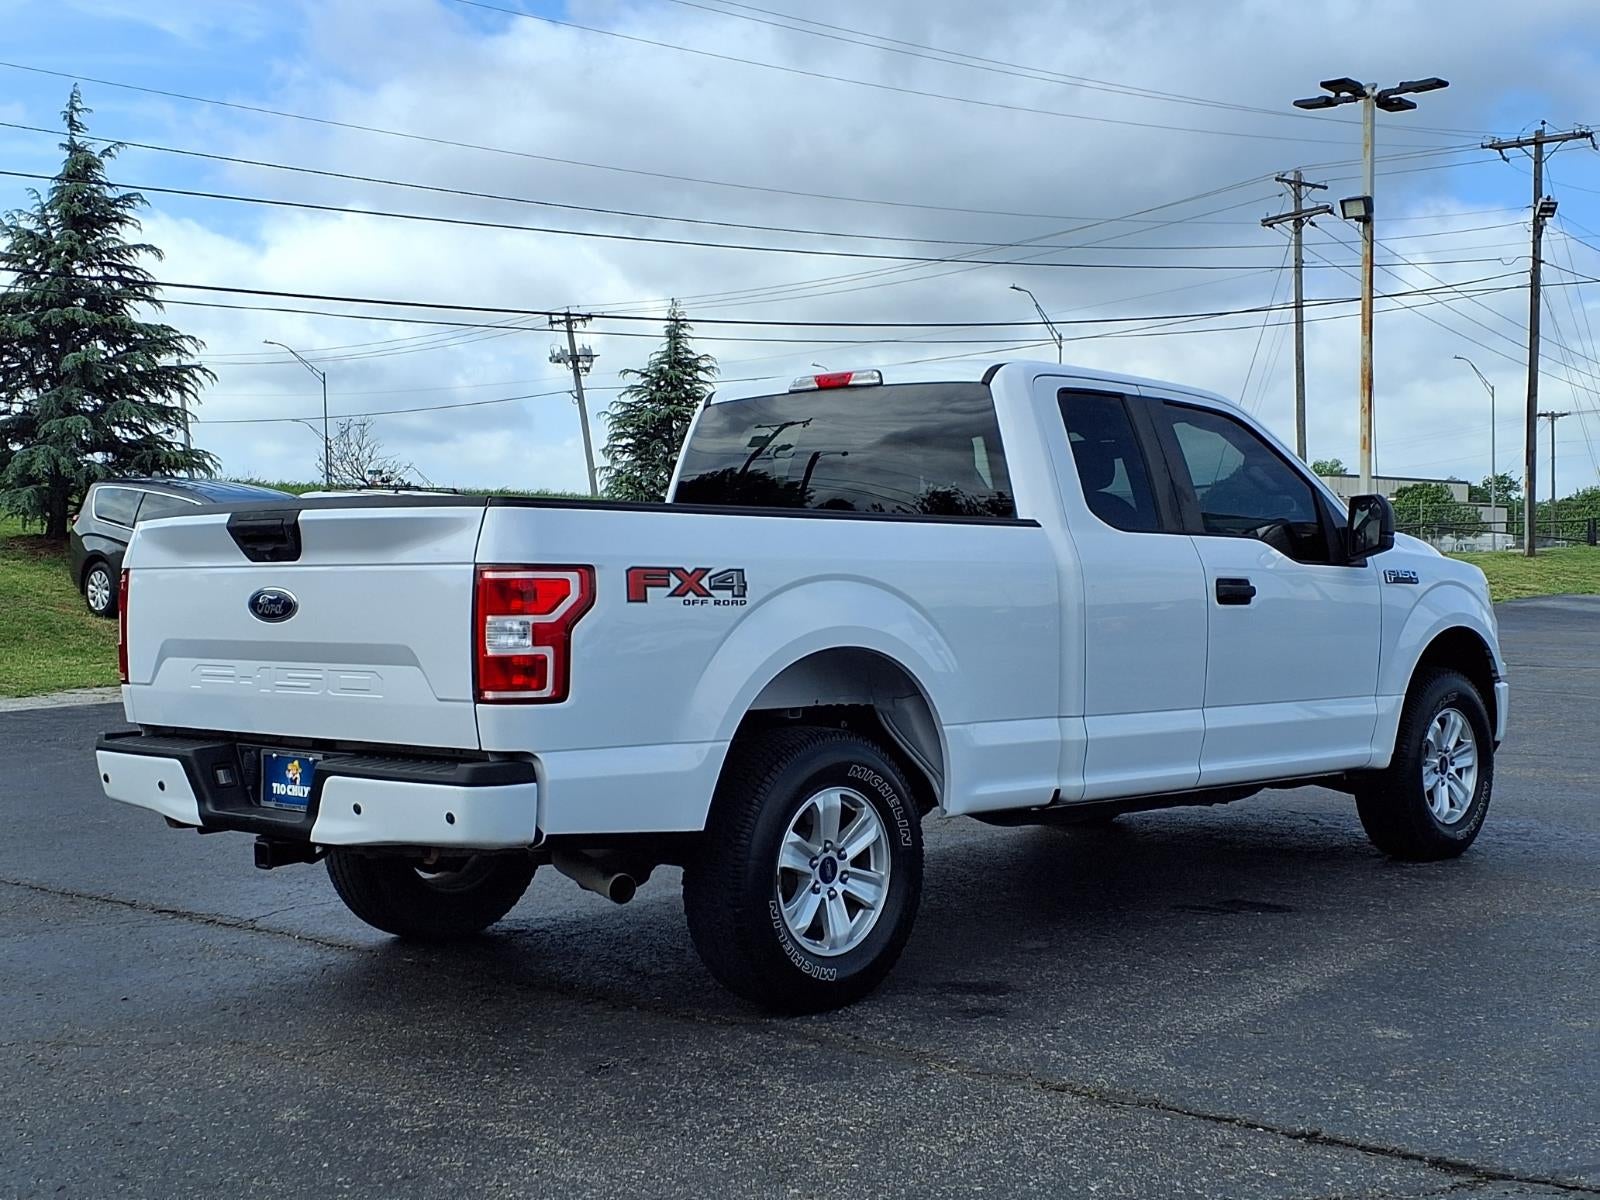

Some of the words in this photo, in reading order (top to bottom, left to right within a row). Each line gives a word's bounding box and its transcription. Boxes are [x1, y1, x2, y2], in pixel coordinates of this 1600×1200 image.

[625, 566, 748, 603] FX4
[682, 599, 709, 607] OFF
[713, 599, 748, 607] ROAD
[190, 663, 384, 699] F-150
[272, 782, 286, 795] TIO
[847, 764, 913, 847] MICHELIN
[769, 900, 837, 982] MICHELIN
